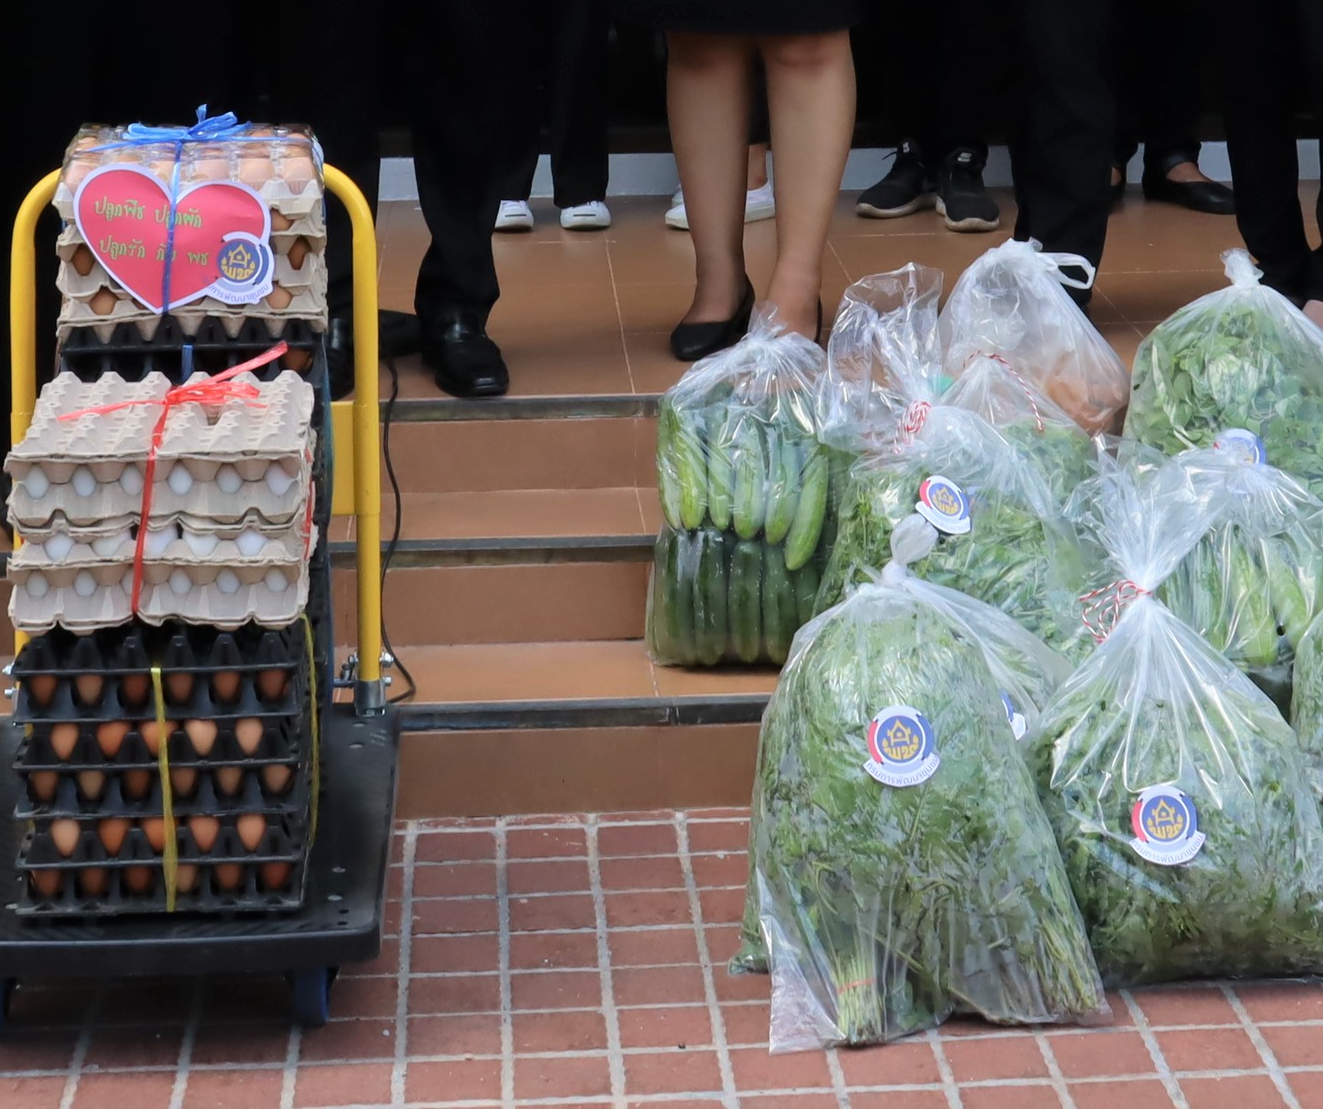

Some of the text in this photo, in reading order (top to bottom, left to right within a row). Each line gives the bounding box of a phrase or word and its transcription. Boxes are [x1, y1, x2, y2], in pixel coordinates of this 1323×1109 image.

[94, 195, 146, 222] ปลูกพืช
[99, 234, 146, 261] ปลูกรัก
[186, 251, 210, 266] พช
